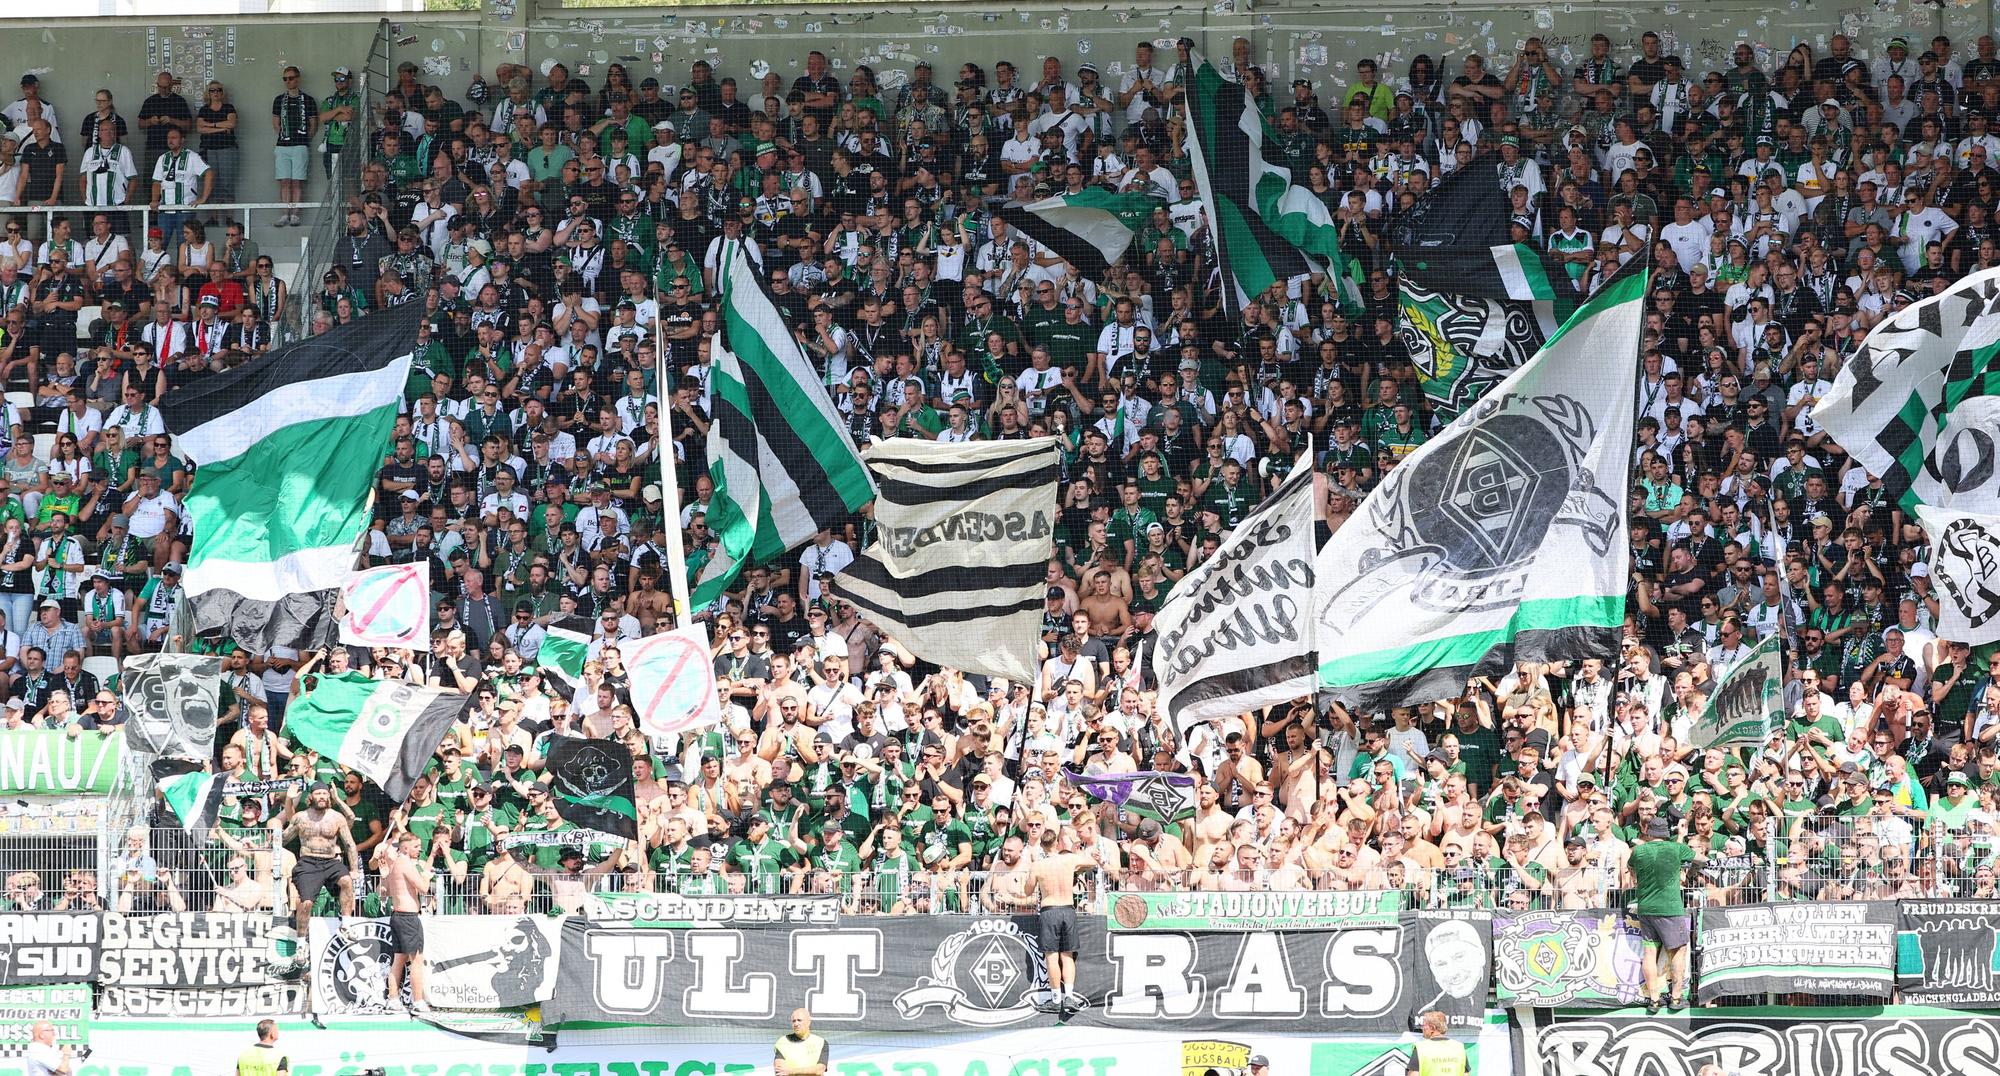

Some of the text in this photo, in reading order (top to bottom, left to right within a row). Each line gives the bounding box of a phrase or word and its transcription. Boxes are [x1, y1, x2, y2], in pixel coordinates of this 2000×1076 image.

[667, 313, 693, 322] ellesse
[587, 897, 839, 924] ASCENDENTE
[1174, 893, 1383, 918] STADIONVERBOT
[1725, 904, 1867, 928] WIR WOLLEN
[103, 912, 272, 949] BEGLEIT
[970, 919, 1018, 936] 1900
[1701, 926, 1784, 950] LIEBER
[98, 948, 266, 986] SERVICE
[1700, 944, 1893, 974] ALS DISKUTIEREN
[53, 990, 87, 1004] DEN
[430, 983, 479, 996] rabauke
[1185, 1054, 1242, 1068] FUSSBALL
